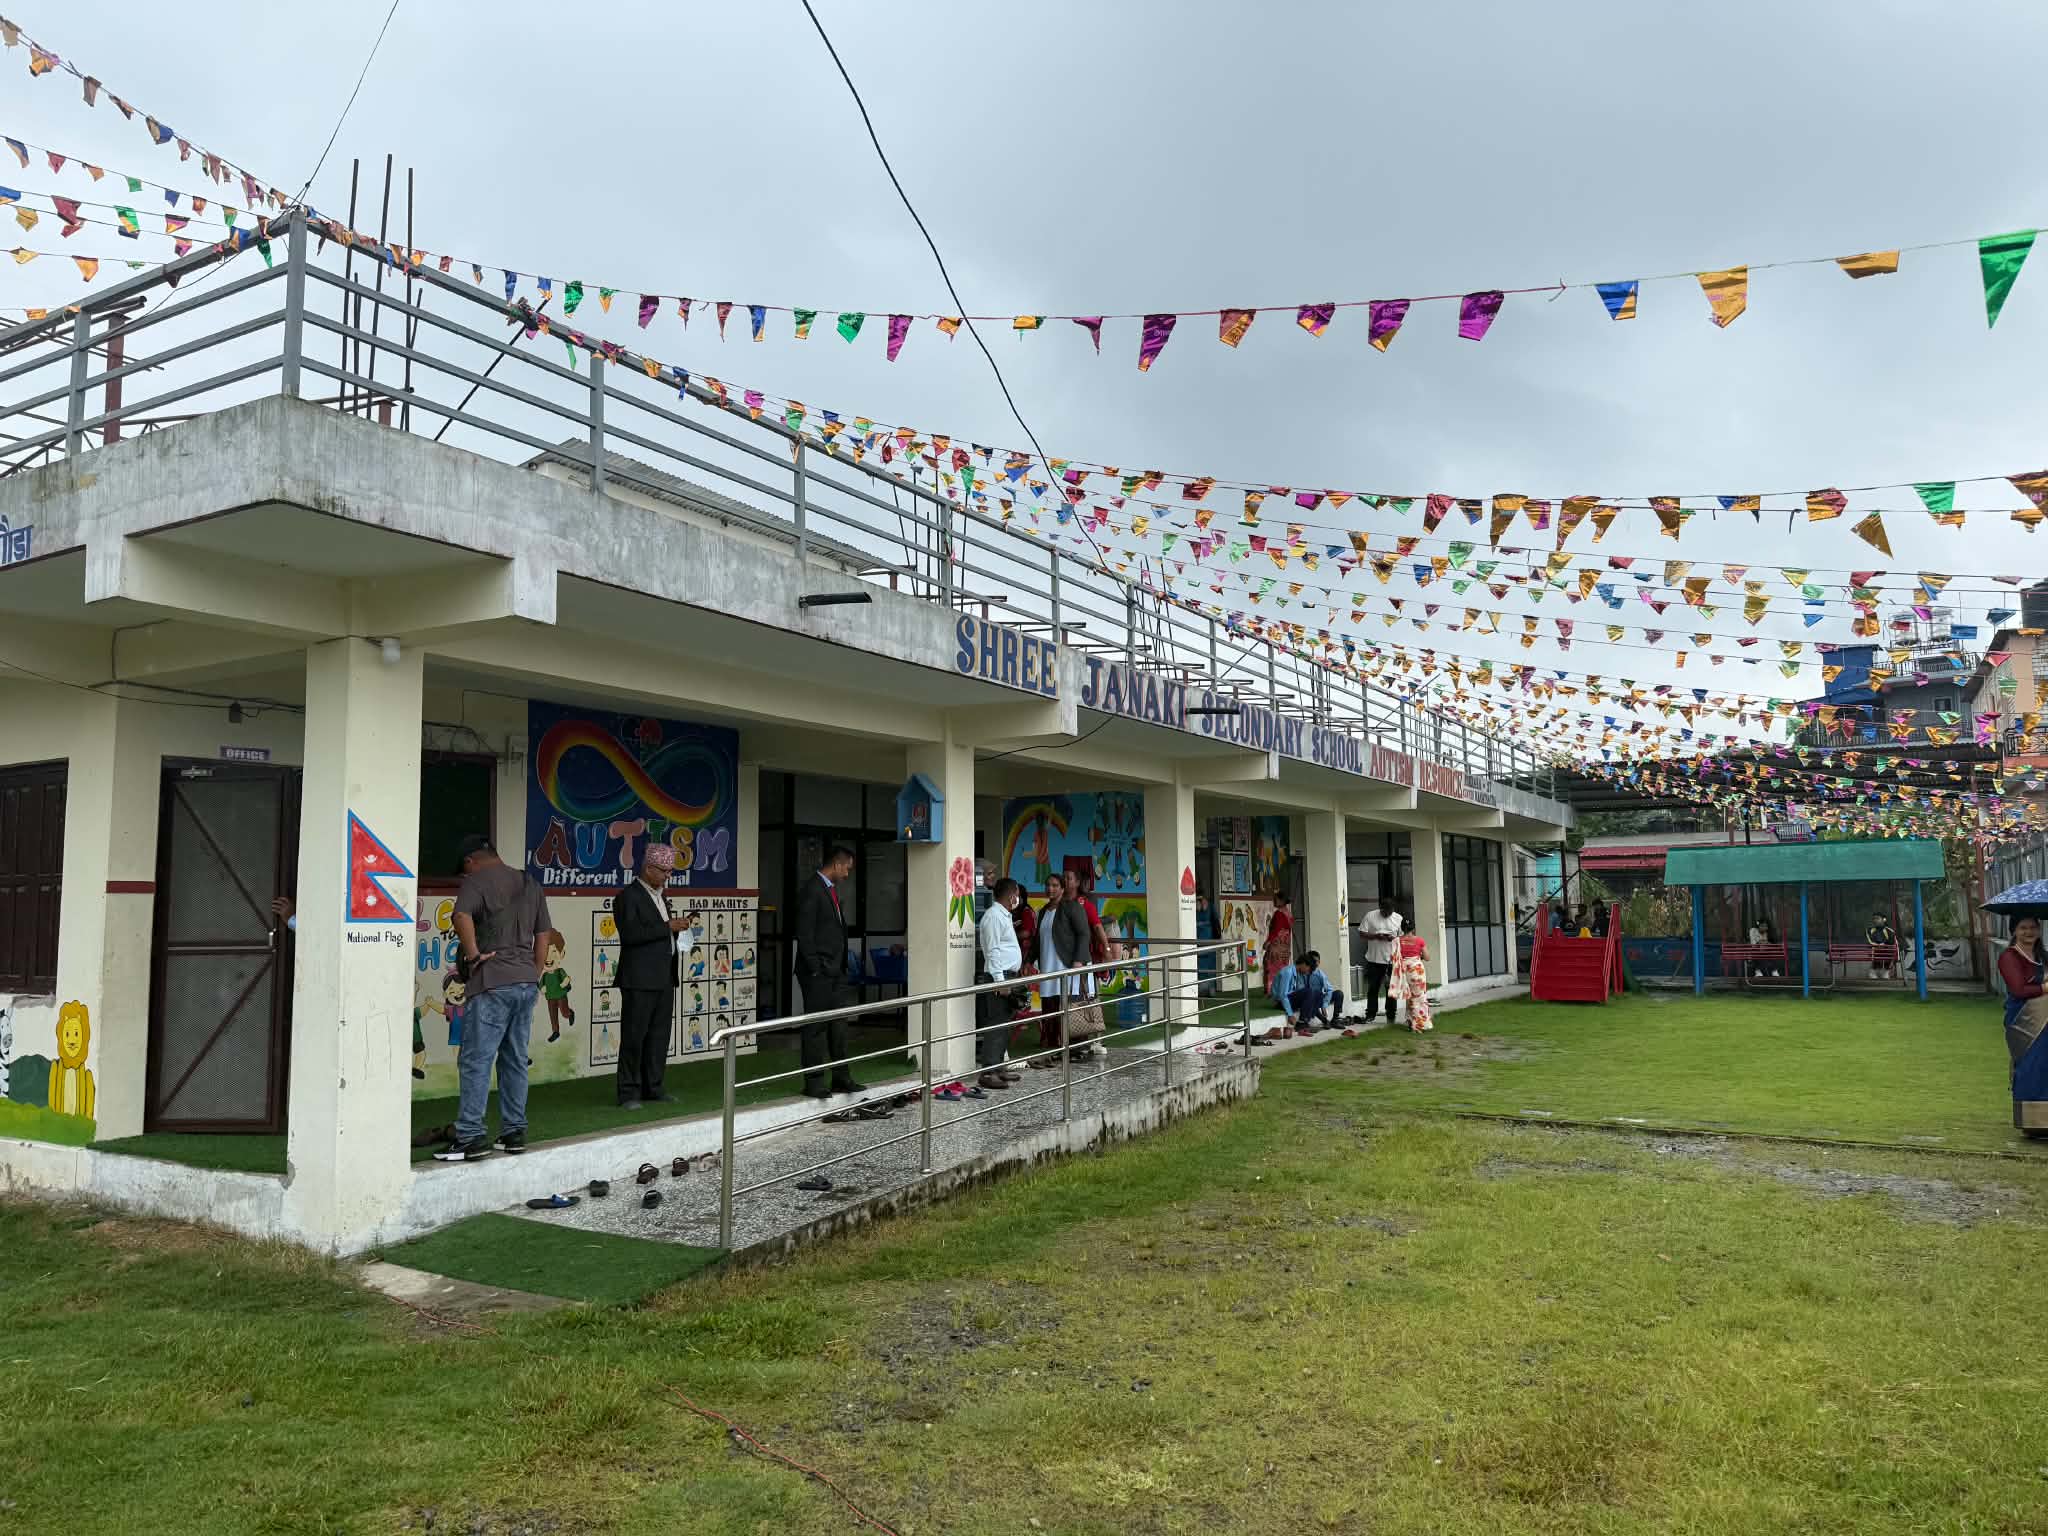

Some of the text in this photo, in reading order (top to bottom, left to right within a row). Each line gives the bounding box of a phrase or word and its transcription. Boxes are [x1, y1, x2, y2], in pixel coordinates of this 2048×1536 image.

[956, 614, 1058, 697] SHREE
[1081, 656, 1187, 729] JANAKI
[1201, 688, 1304, 758] SECONDARY
[1312, 724, 1363, 774] SCHOOL
[1370, 743, 1414, 787] AUTISM
[225, 748, 265, 760] OFFICE
[543, 867, 618, 886] Different
[689, 898, 749, 909] BAD HABITS
[347, 930, 404, 948] National Flag
